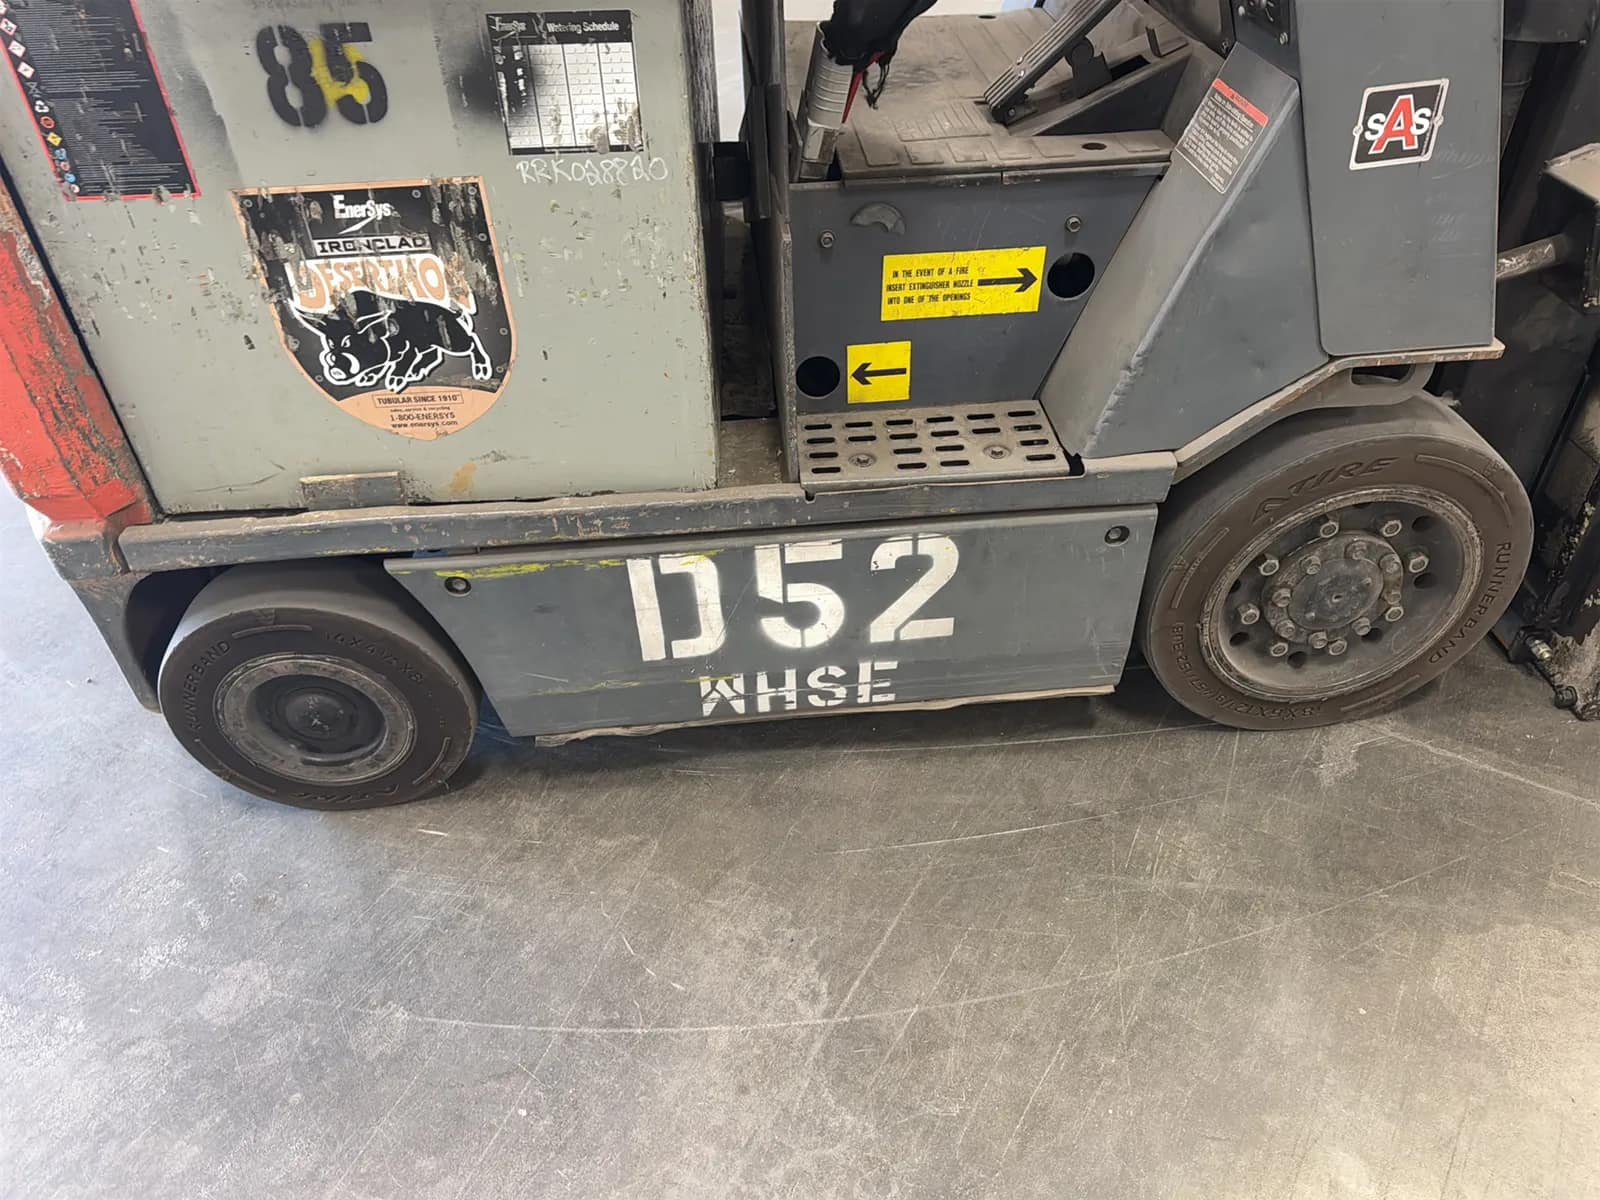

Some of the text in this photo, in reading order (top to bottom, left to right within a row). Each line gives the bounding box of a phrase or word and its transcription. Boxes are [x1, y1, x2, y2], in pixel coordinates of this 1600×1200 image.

[546, 21, 619, 34] Watering Schedule
[256, 22, 388, 128] 85
[333, 194, 392, 220] EnerSys
[317, 236, 426, 253] IRONCLAD
[892, 266, 969, 278] IN THE EVENT OF A FIRE
[886, 279, 973, 292] INSERT EXTINGUISHER NOZZLE
[888, 292, 971, 305] INTO ONE OF THE OPENINGS
[377, 396, 413, 405] TUBULAR
[414, 395, 436, 403] SINCE
[390, 411, 456, 421] 1-800-ENERSYS
[391, 420, 458, 429] www.enersys.com
[700, 661, 898, 716] WHSE
